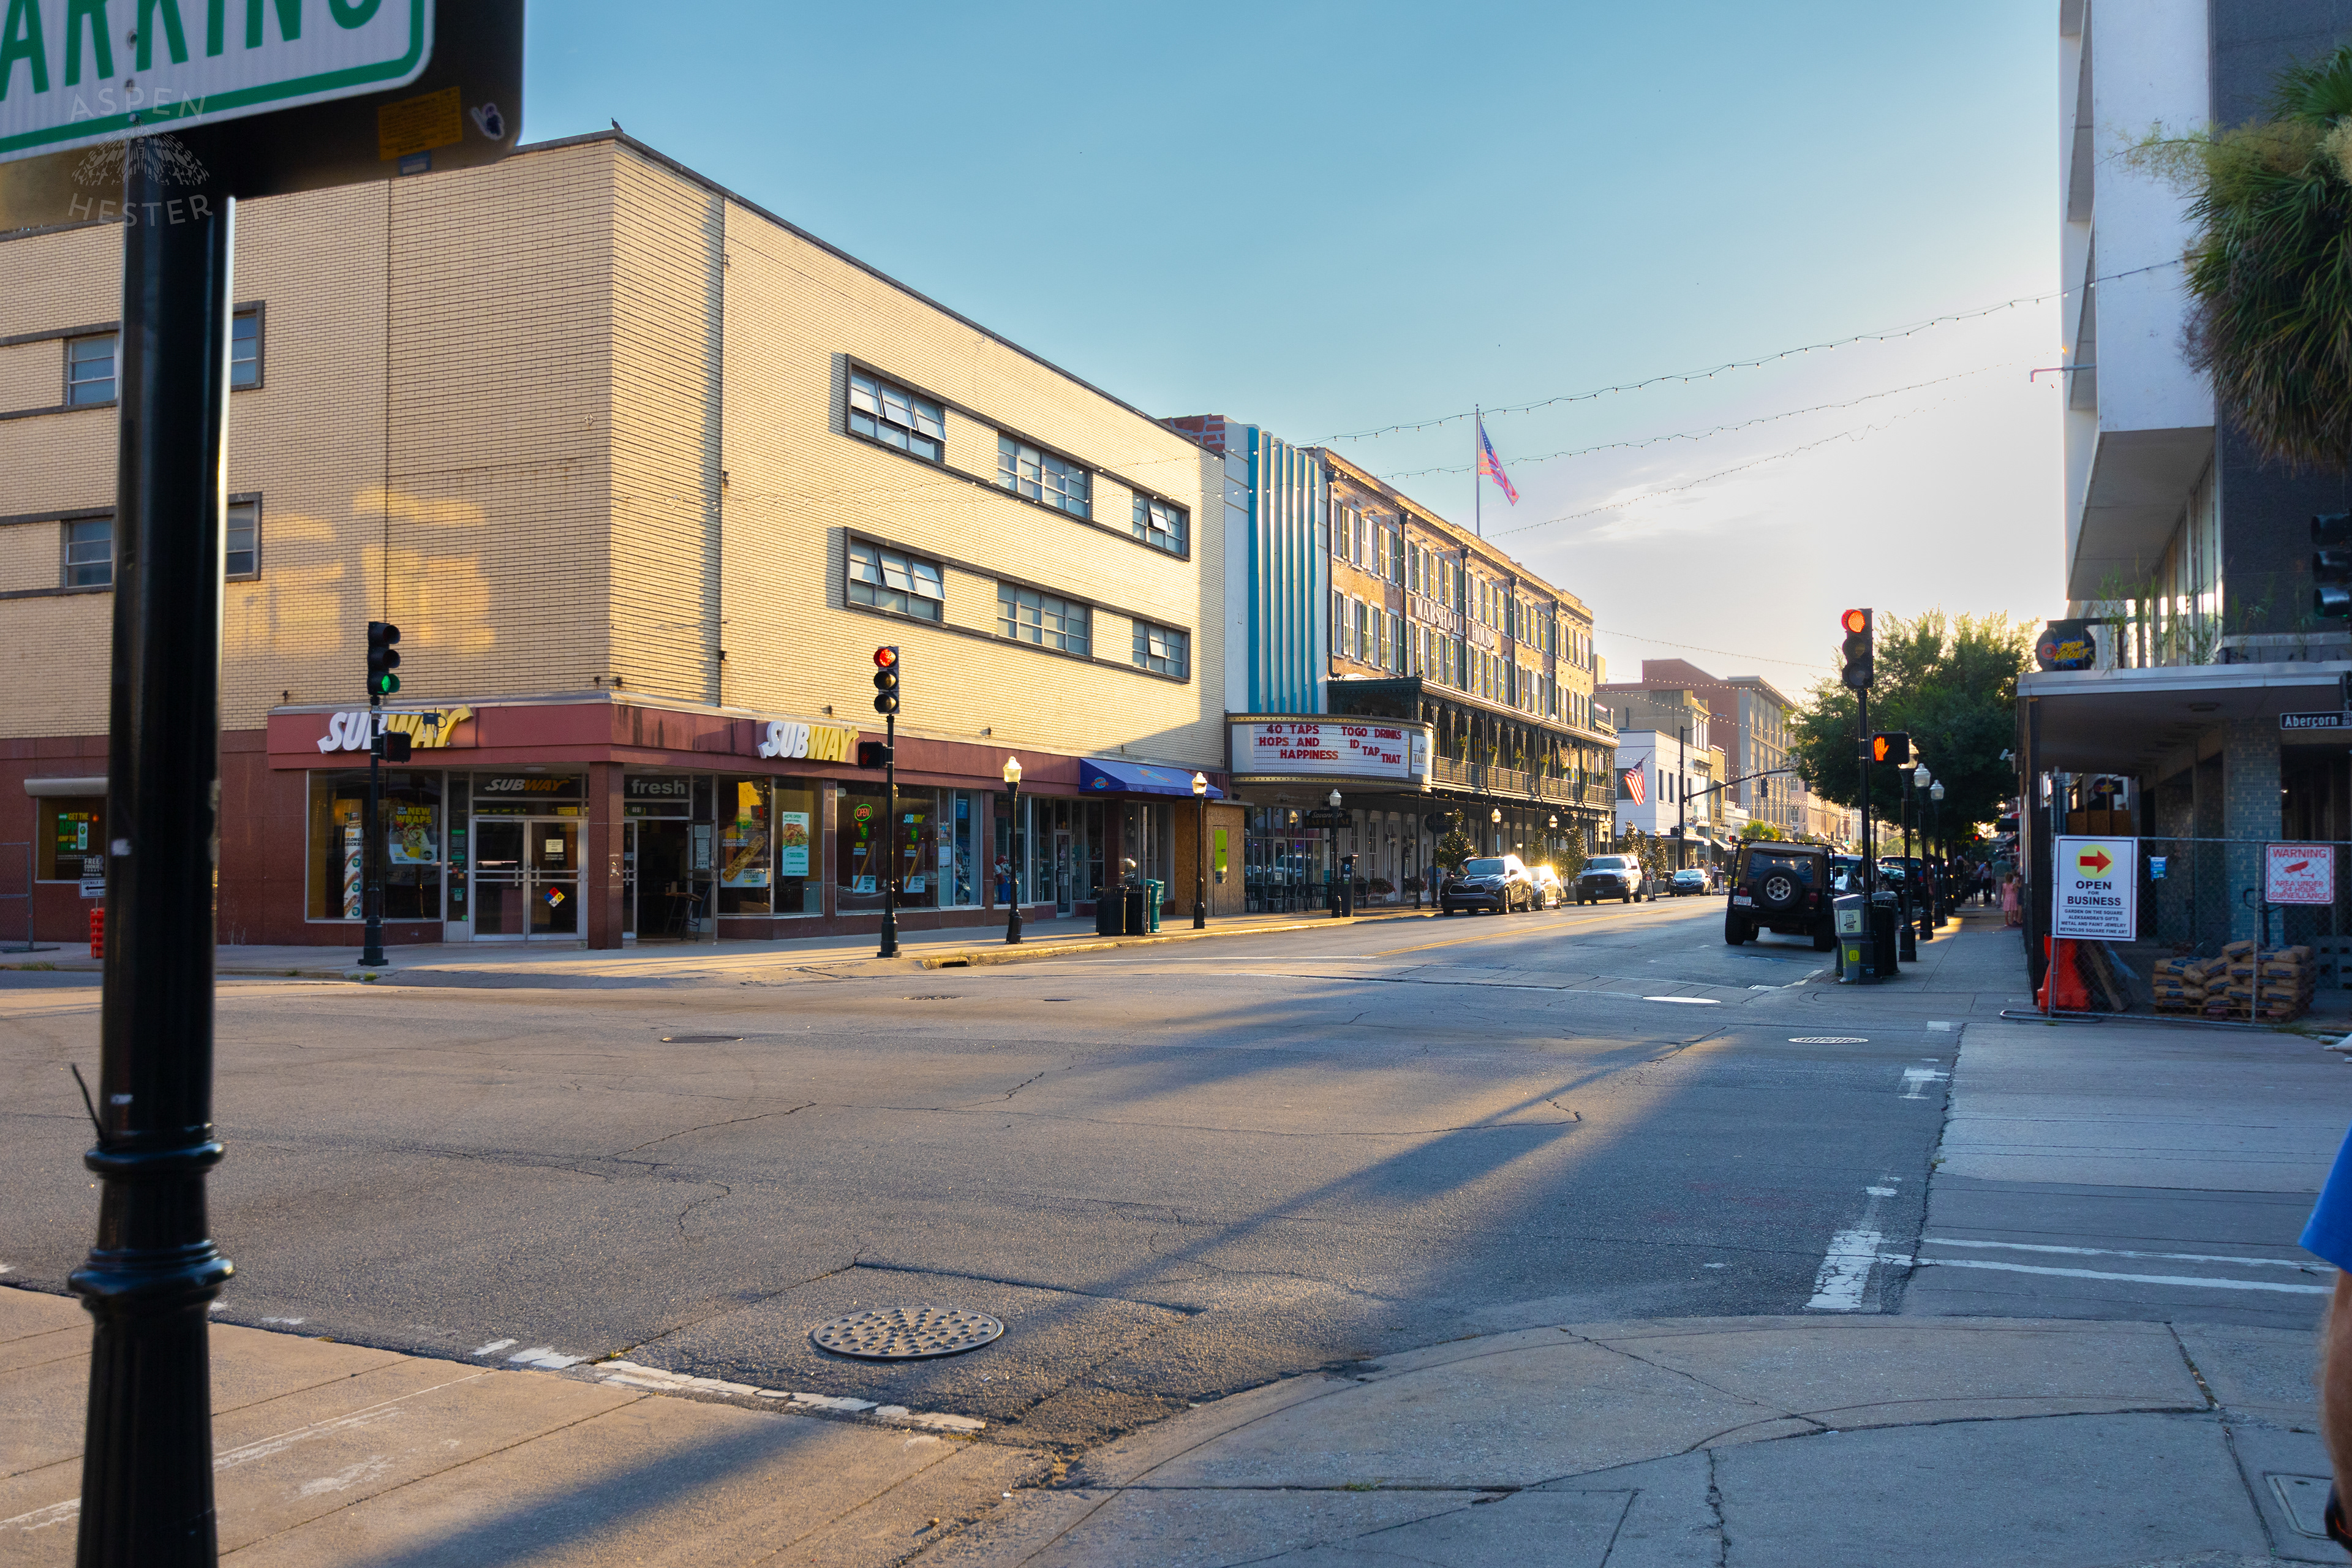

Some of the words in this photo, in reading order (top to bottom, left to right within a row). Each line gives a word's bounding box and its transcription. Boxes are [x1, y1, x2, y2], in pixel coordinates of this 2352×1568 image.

[1415, 596, 1464, 636] MARSHALL
[1471, 622, 1495, 649] HOUSE
[2285, 715, 2338, 727] Abercorn
[1267, 725, 1283, 734] 40
[1290, 725, 1319, 734] TAPS
[1341, 726, 1368, 737] TOGO
[1374, 728, 1401, 740] DRINKS
[758, 720, 859, 761] SUBWAY
[1259, 737, 1289, 746] HOPS
[1297, 737, 1319, 747] AND
[1349, 739, 1360, 748] ID
[1280, 749, 1339, 760] HAPPINESS
[1362, 746, 1380, 756] TAP
[1381, 753, 1401, 764] THAT
[484, 778, 570, 791] SUBWAY
[631, 779, 685, 794] fresh
[407, 807, 431, 815] NEW
[857, 808, 870, 817] OPEN
[903, 814, 925, 823] SUBWAY
[58, 821, 78, 834] APP
[2273, 849, 2327, 858] WARNING
[2076, 881, 2112, 890] OPEN
[2067, 896, 2121, 906] BUSINESS
